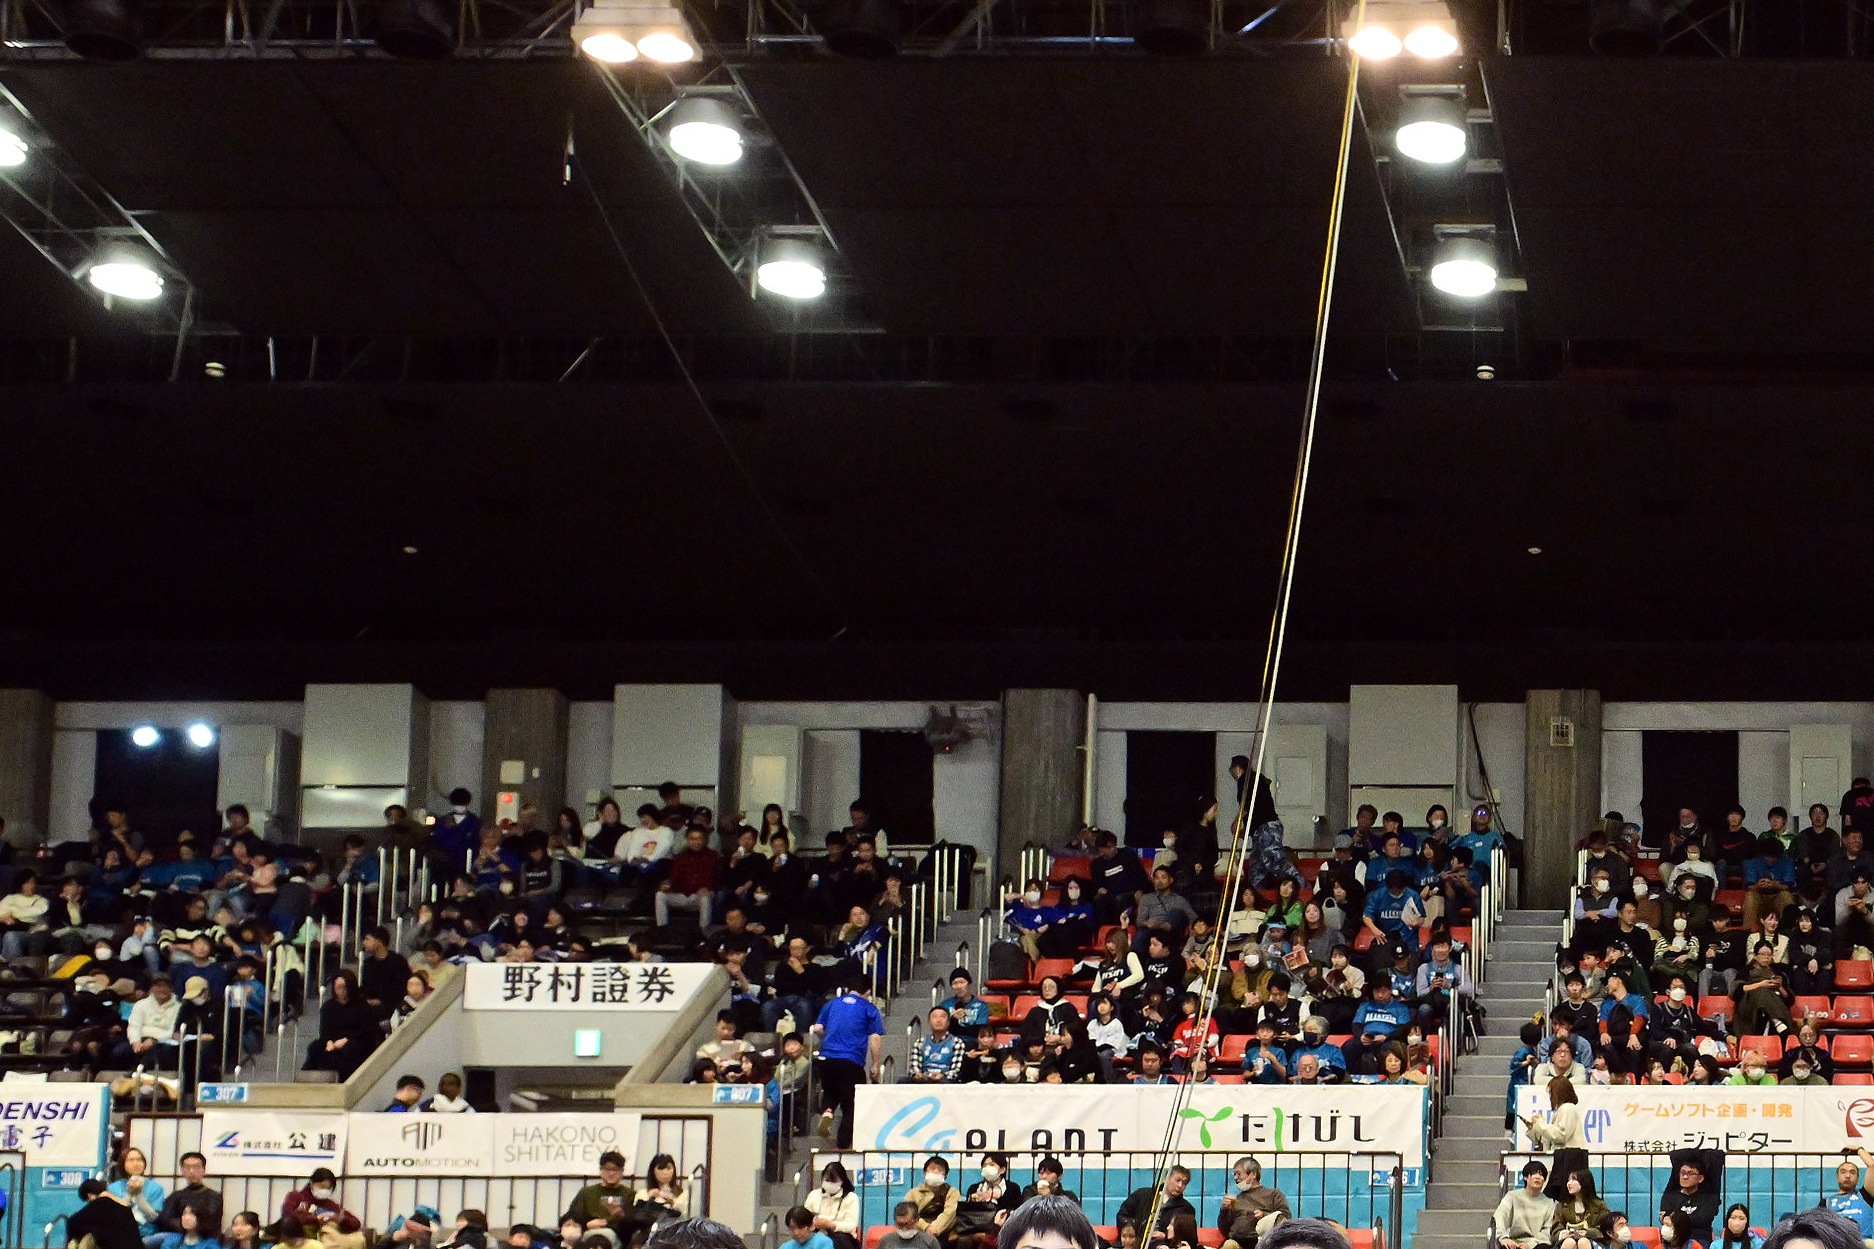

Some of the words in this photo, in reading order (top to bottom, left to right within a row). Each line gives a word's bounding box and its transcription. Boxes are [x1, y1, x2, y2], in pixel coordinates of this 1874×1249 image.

[502, 966, 675, 1003] 野村證券
[216, 1086, 237, 1100] 307
[0, 1102, 90, 1120] ENSHI
[1623, 1102, 1794, 1118] ゲームソフト企画・開発
[511, 1126, 617, 1143] HAKONO
[1623, 1139, 1678, 1152] 株式会社
[1683, 1131, 1793, 1152] ジュピター
[362, 1157, 480, 1168] AUTOMOTION
